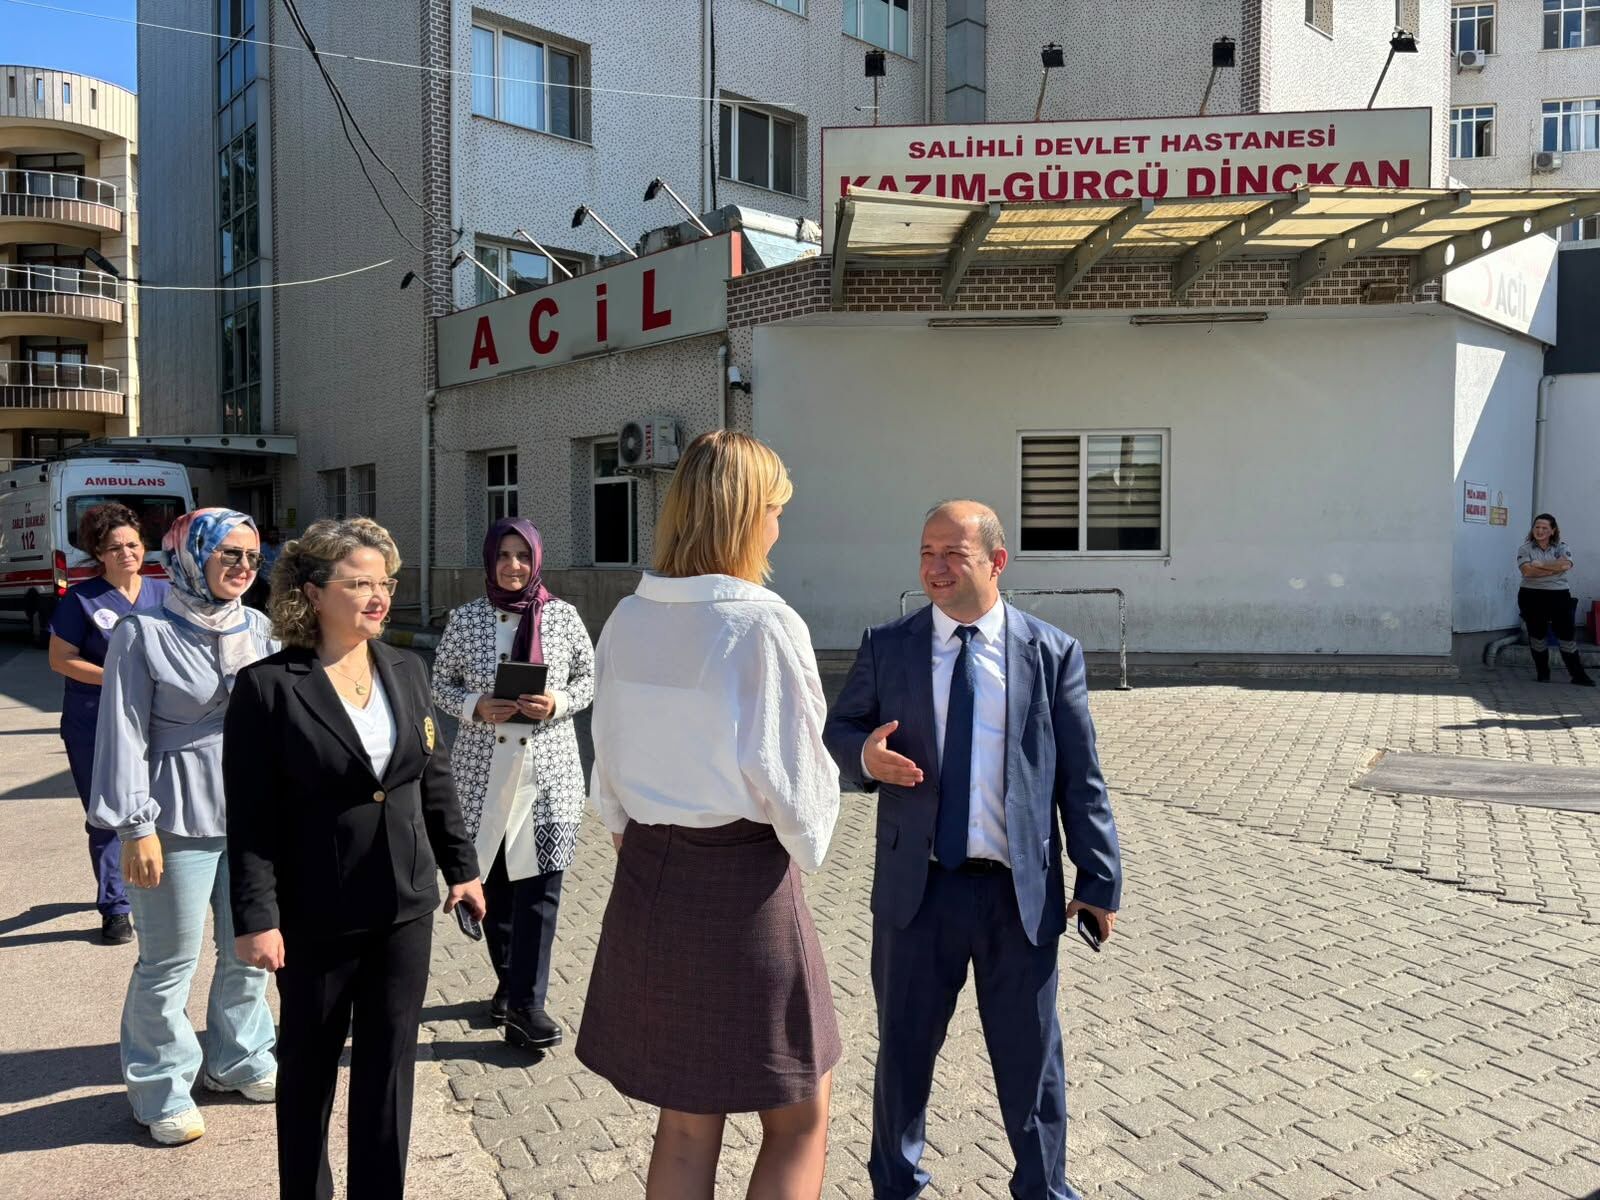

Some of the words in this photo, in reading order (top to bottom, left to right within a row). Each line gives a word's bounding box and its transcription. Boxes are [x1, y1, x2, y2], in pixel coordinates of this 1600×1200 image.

[908, 134, 1023, 159] SALİHLİ
[1035, 136, 1151, 156] DEVLET
[1161, 124, 1336, 152] HASTANESİ
[469, 268, 672, 370] ACİL
[85, 477, 166, 487] AMBULANS
[21, 530, 36, 550] 112
